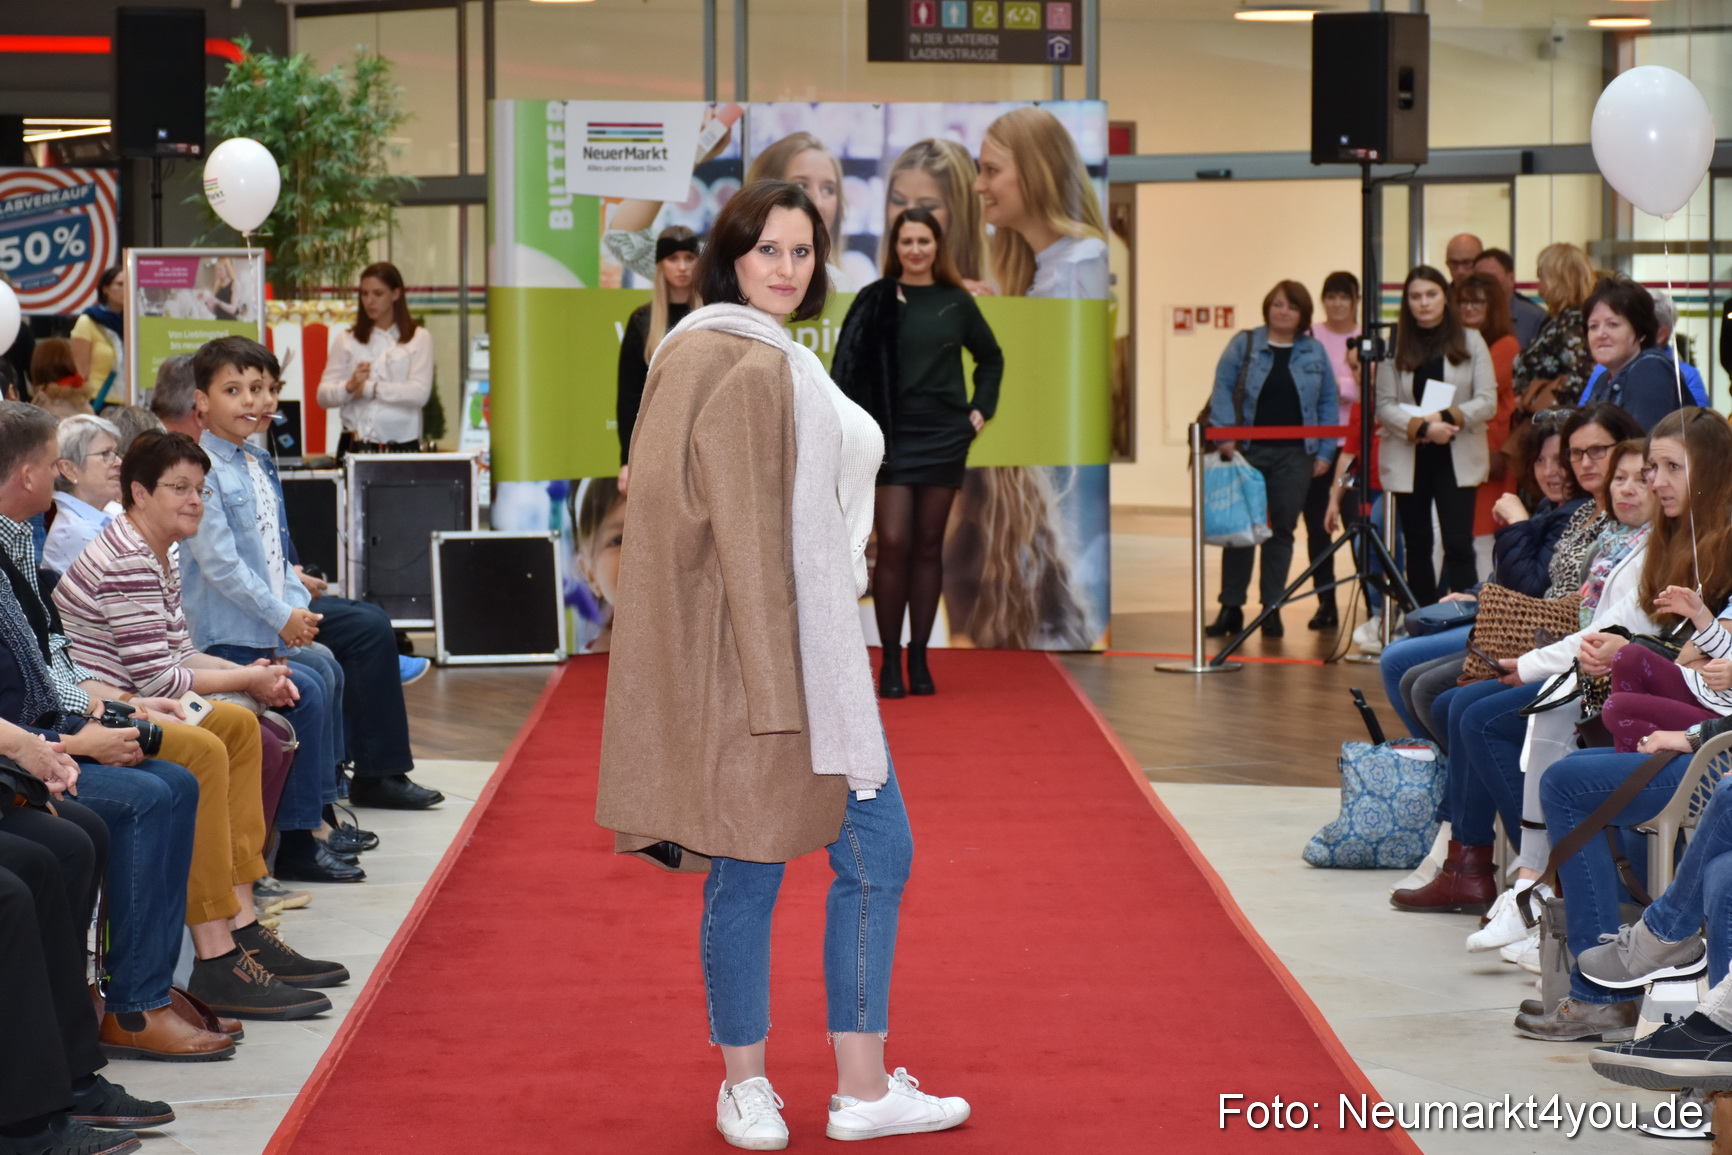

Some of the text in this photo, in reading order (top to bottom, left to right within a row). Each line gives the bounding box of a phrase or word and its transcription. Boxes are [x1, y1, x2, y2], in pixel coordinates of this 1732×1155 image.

[910, 33, 1000, 45] IN DER UNTEREN
[909, 47, 999, 60] LADENSTRASSE
[583, 146, 669, 161] NeuerMarkt
[603, 165, 622, 173] unter
